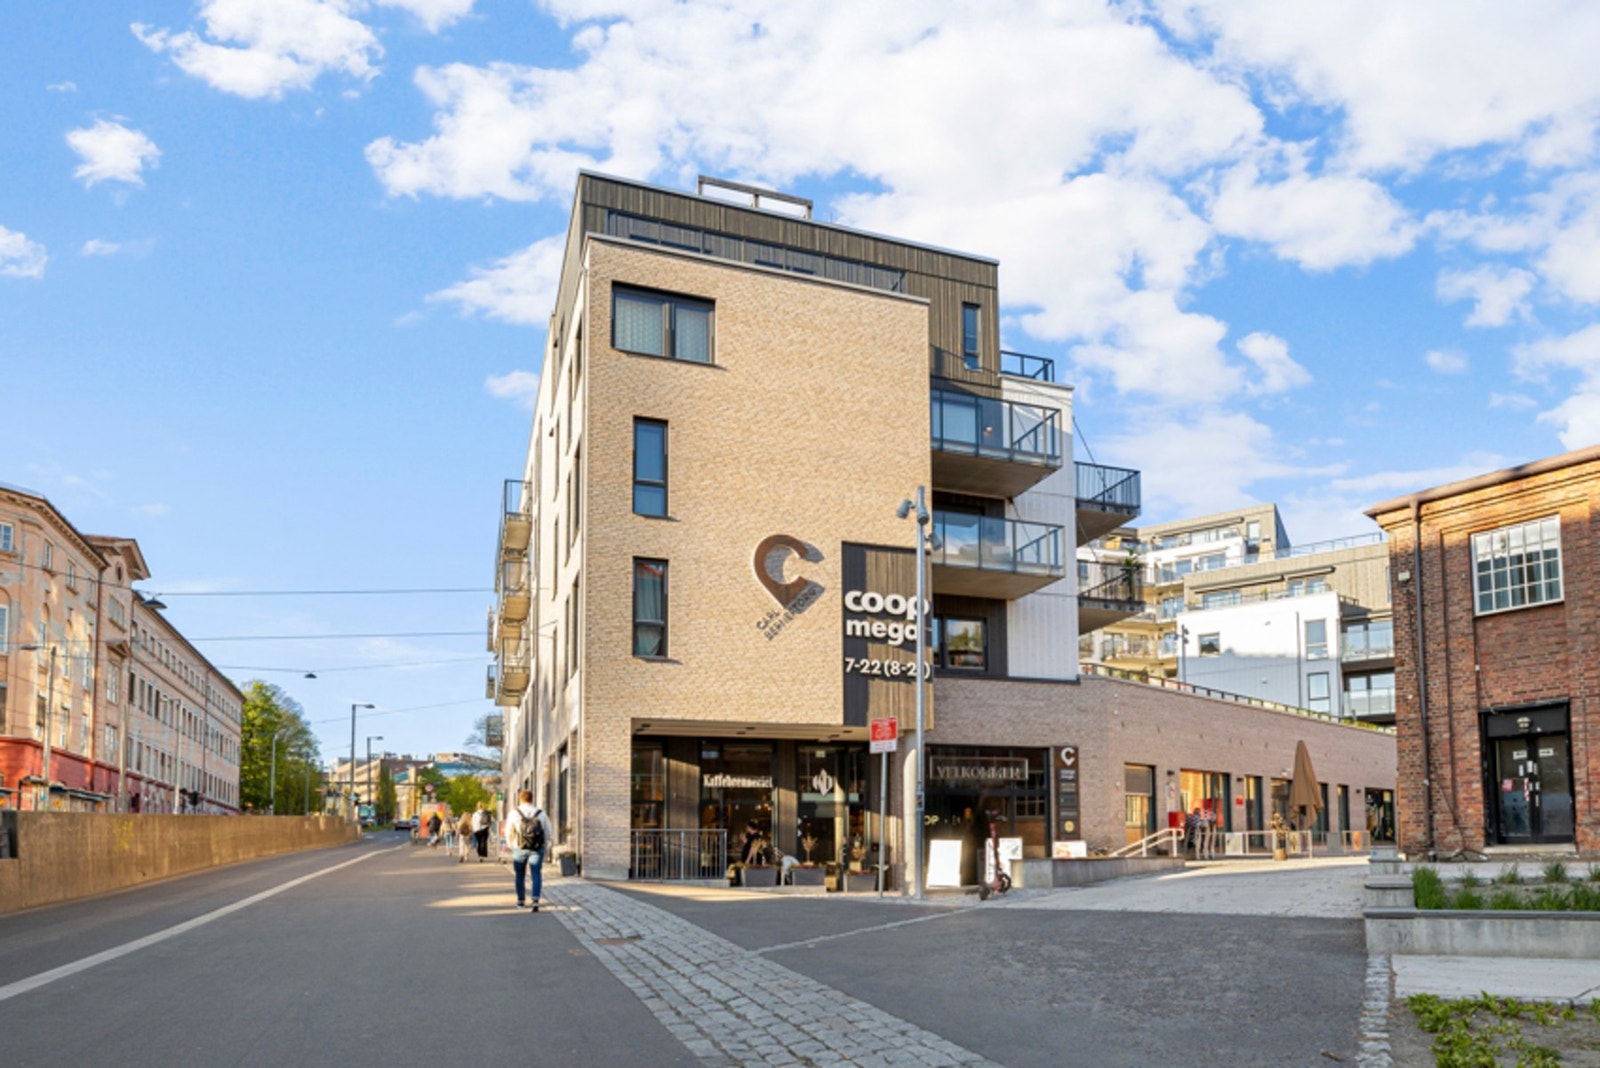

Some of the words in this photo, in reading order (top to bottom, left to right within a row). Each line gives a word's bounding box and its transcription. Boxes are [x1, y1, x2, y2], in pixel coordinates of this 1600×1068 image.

[844, 591, 930, 620] coop
[846, 619, 917, 646] mega
[845, 657, 882, 673] 7-22
[884, 660, 931, 679] (8-2)
